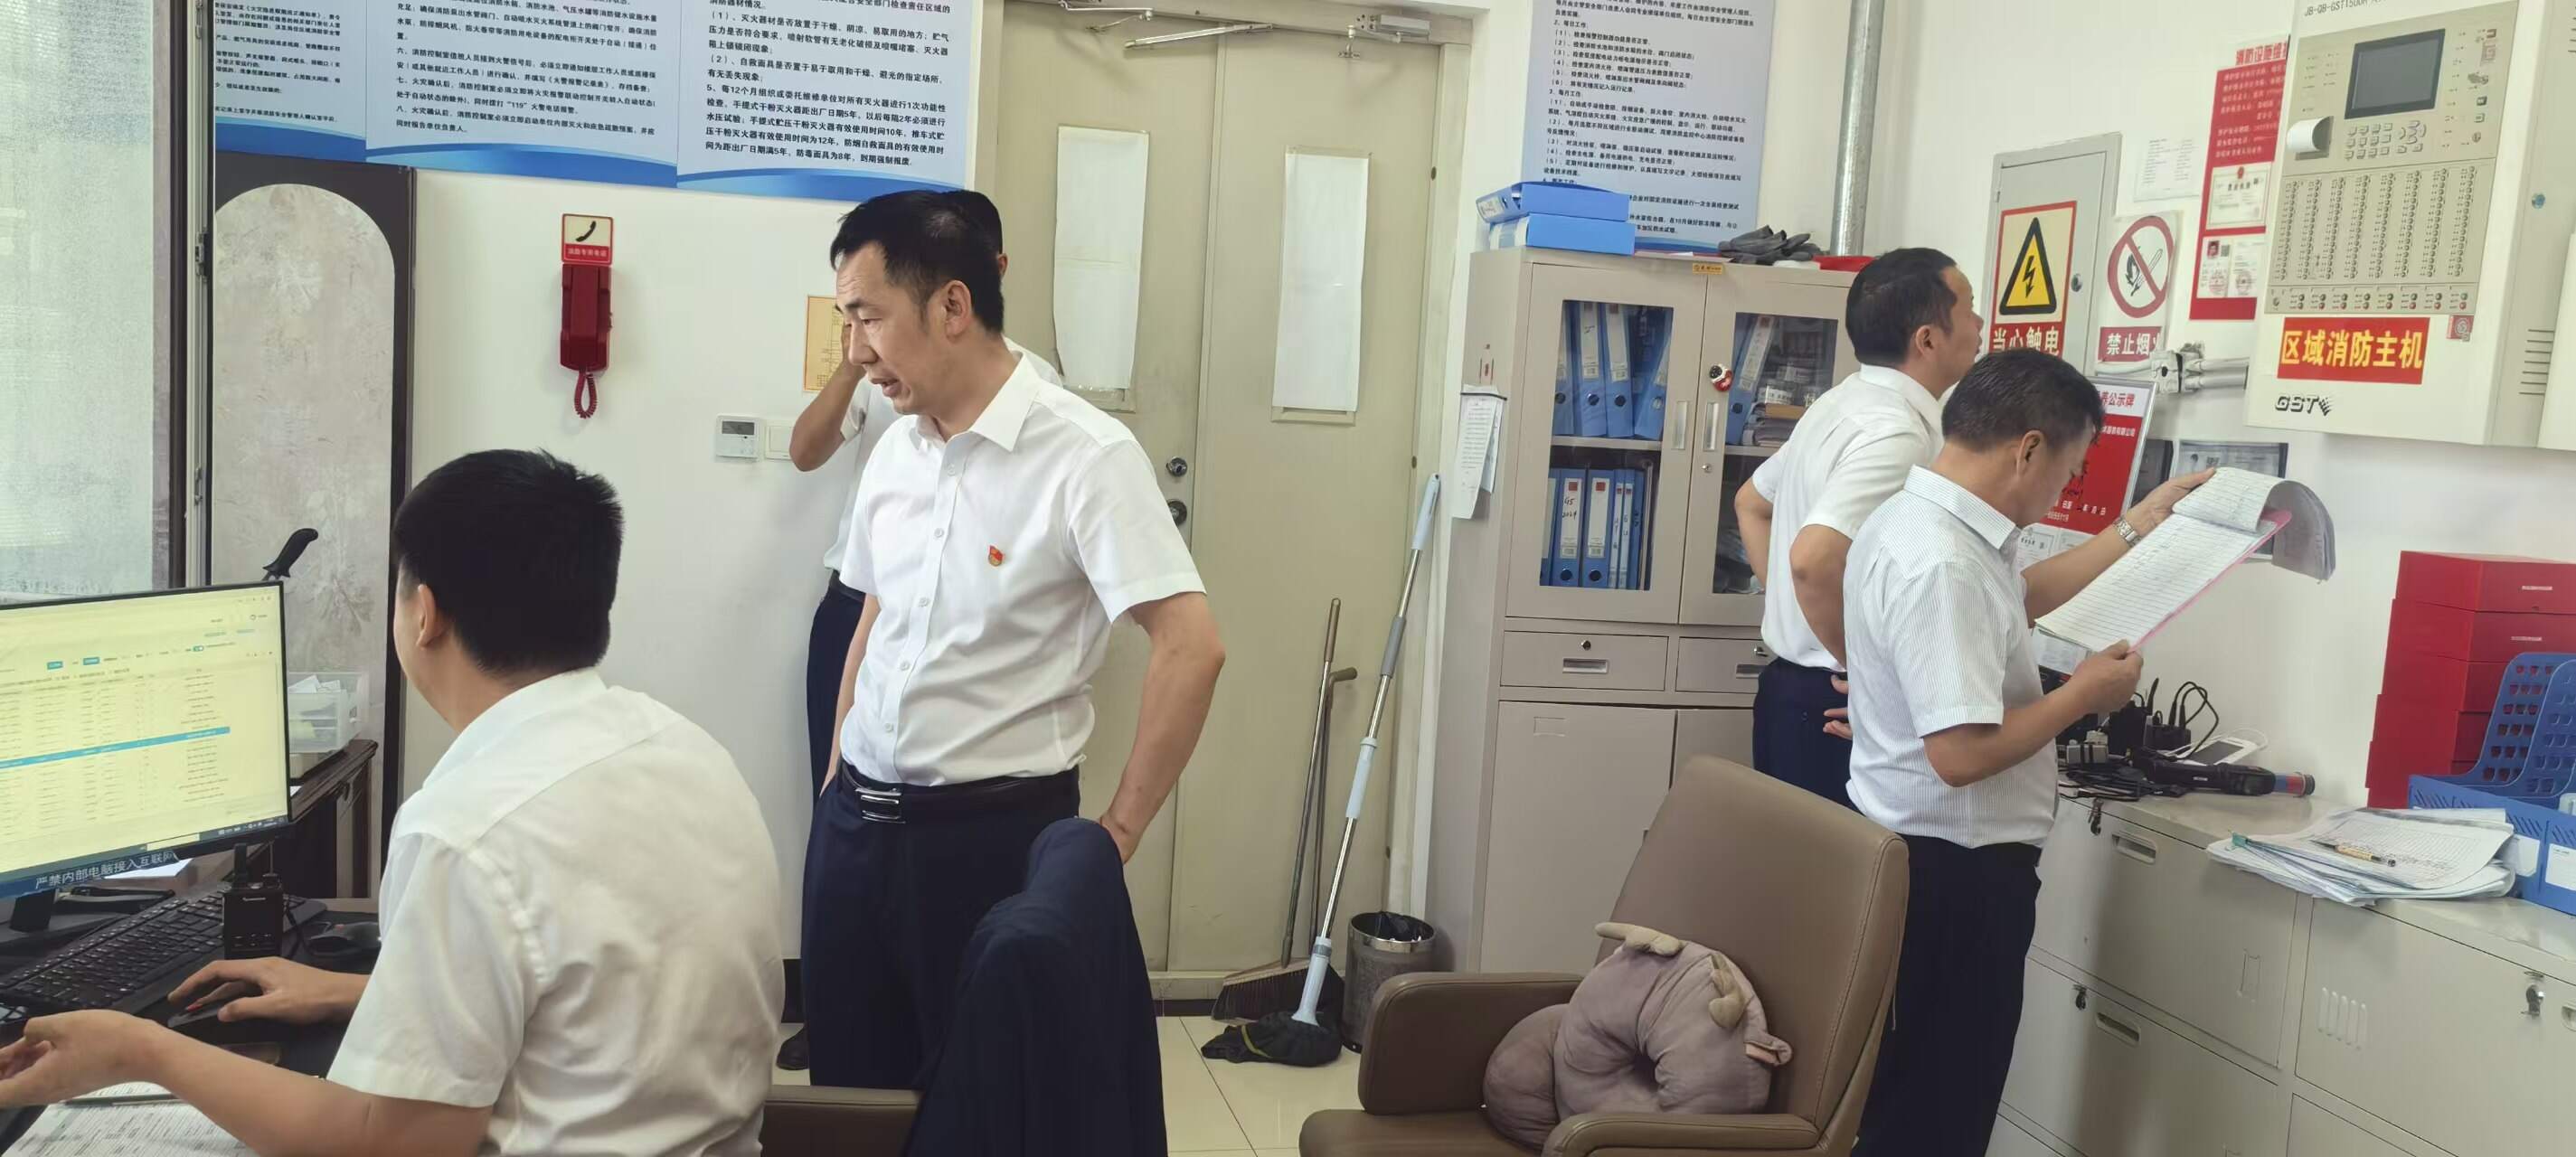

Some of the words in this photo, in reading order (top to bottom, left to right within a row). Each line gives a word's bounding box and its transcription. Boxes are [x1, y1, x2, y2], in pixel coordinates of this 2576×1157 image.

[1993, 325, 2060, 356] 当心触电
[2279, 329, 2424, 369] 区域消防主机
